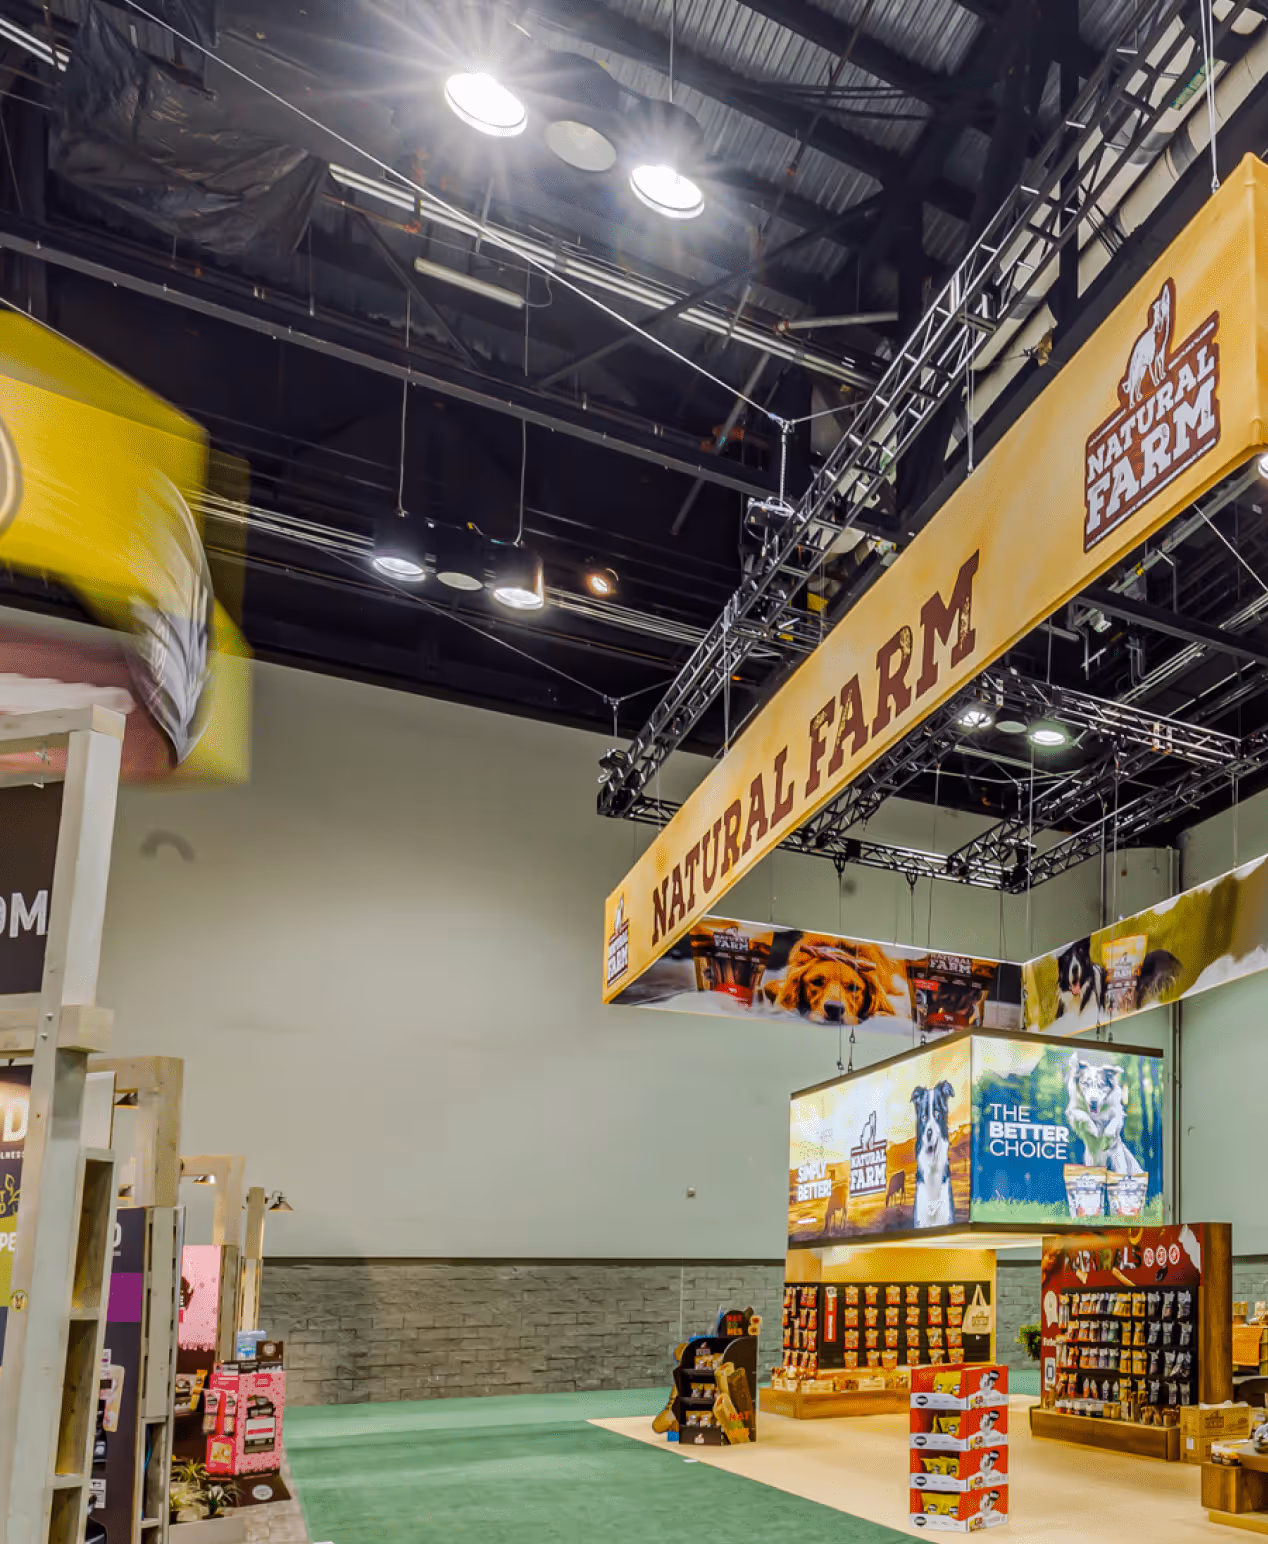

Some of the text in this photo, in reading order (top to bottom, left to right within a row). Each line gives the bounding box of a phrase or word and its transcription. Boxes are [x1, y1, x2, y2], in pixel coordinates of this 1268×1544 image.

[1087, 343, 1216, 484] NATURAL
[1086, 375, 1216, 536] FARM
[651, 548, 981, 948] NATURAL FARM
[713, 939, 750, 951] FARM
[929, 960, 972, 975] FARM
[989, 1103, 1032, 1123] THE
[989, 1121, 1070, 1143] BETTER
[850, 1148, 888, 1169] NATURAL
[989, 1139, 1069, 1160] CHOICE
[797, 1160, 828, 1183] SIMPLY
[850, 1164, 888, 1191] FARM
[797, 1178, 833, 1202] BETTER!
